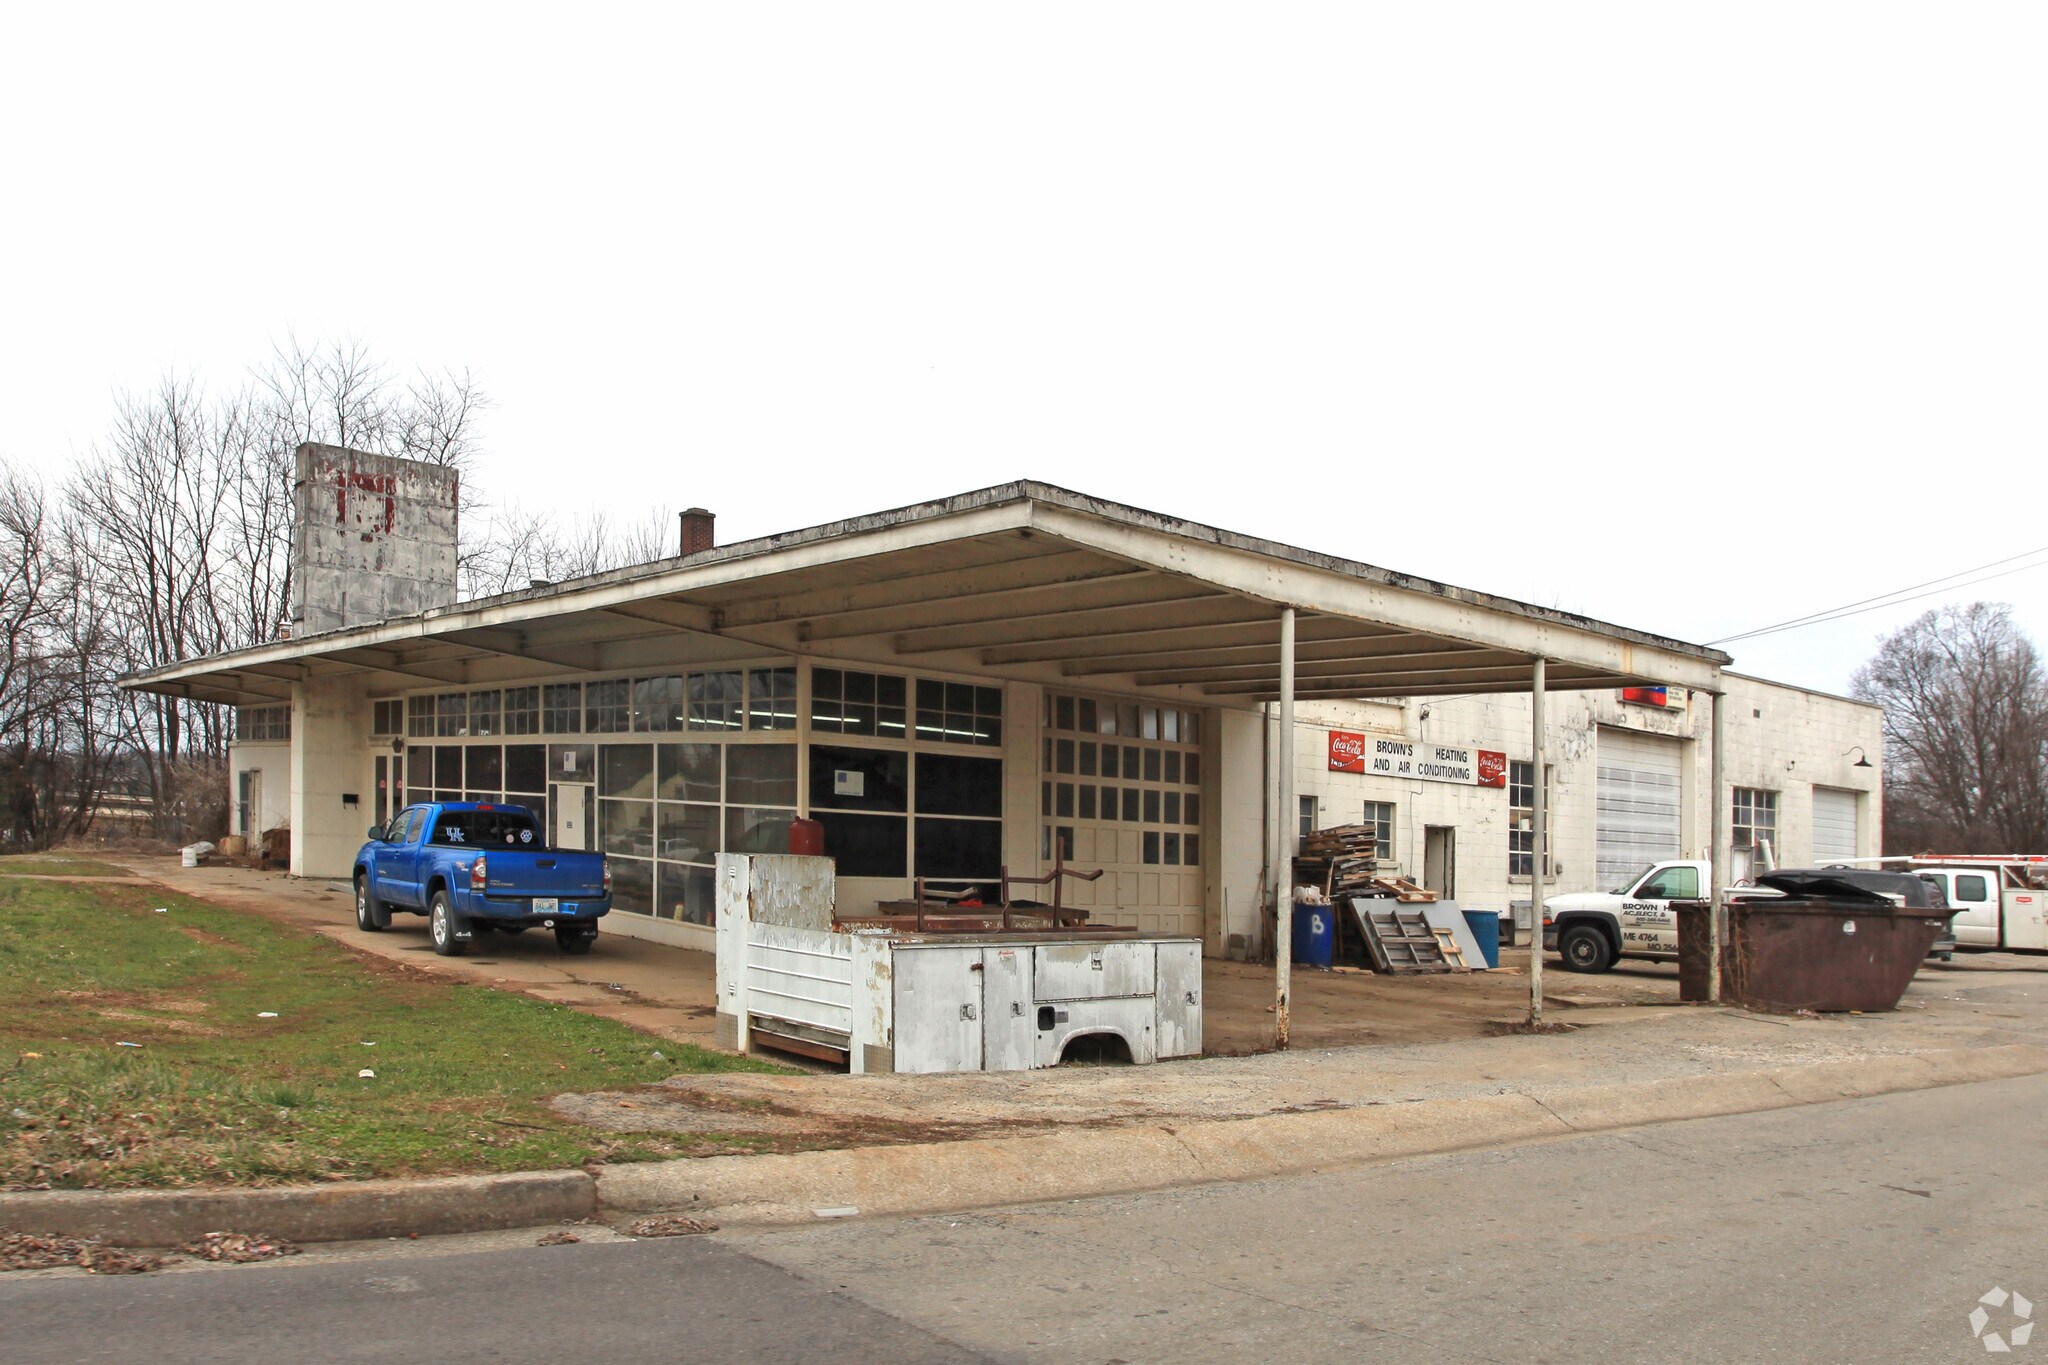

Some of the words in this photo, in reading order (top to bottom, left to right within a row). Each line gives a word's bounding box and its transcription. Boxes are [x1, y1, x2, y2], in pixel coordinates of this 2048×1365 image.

[1376, 740, 1413, 757] BROWN'S
[1435, 747, 1468, 763] HEATING
[1373, 758, 1390, 771] AND
[1398, 761, 1411, 773] AIR
[1417, 763, 1470, 780] CONDITIONING
[1622, 903, 1658, 911] BROWN
[1623, 932, 1636, 941] ME
[1638, 933, 1658, 942] 4764
